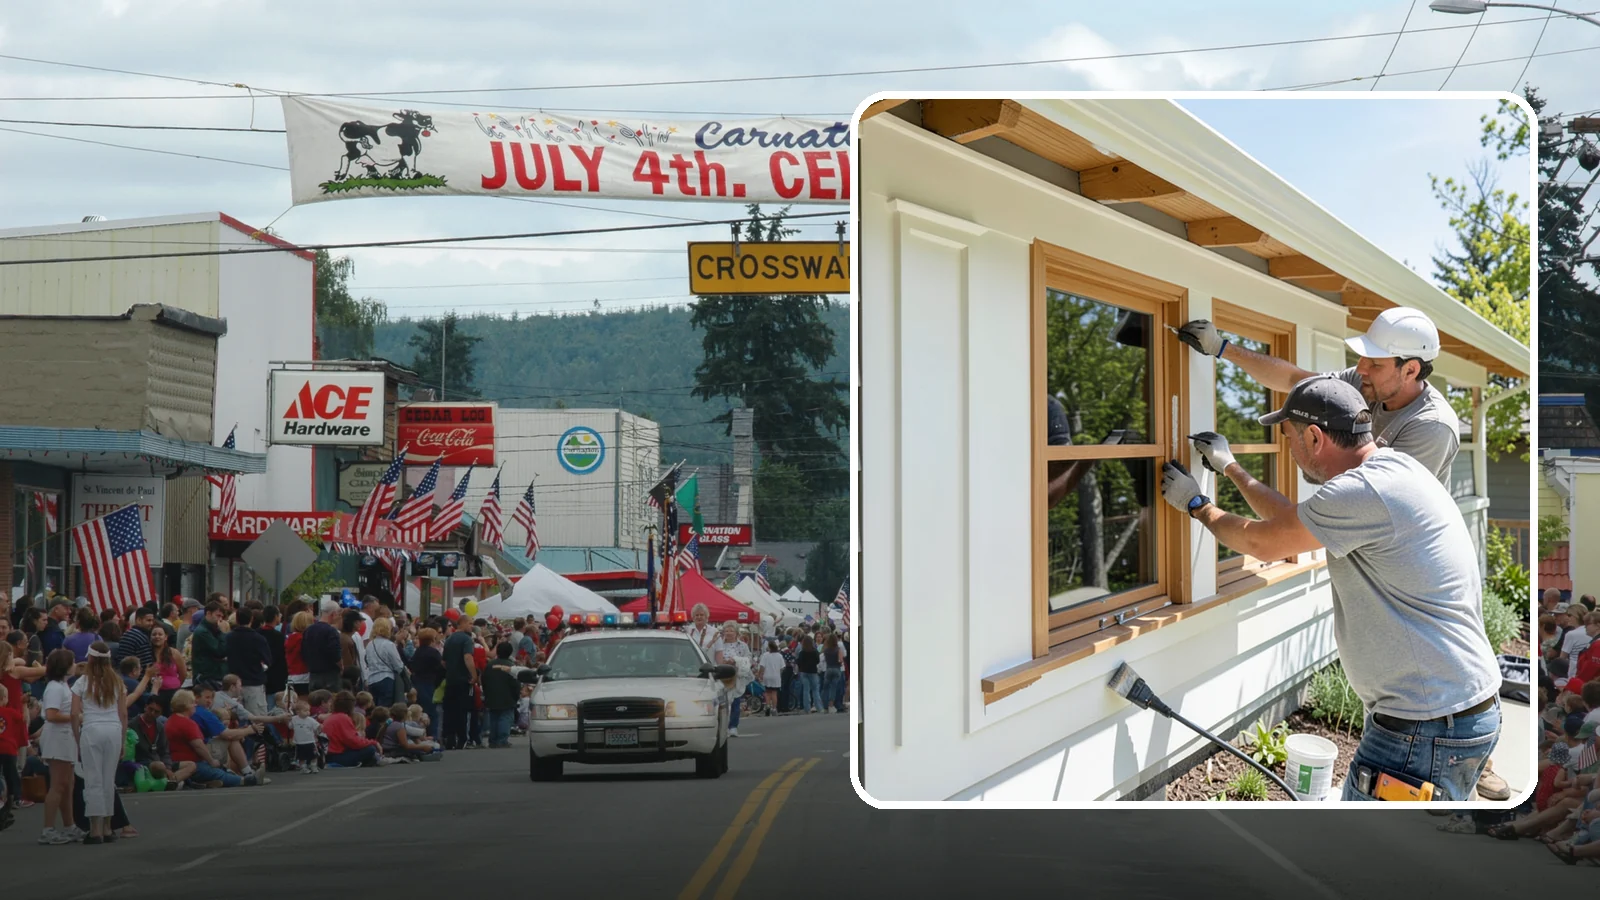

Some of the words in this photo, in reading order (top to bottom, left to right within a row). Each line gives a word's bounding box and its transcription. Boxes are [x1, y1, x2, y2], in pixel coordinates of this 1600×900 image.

[694, 121, 850, 150] Carnat
[481, 141, 604, 192] JULY
[632, 150, 746, 198] 4th.
[696, 253, 850, 280] CROSSWA
[282, 380, 373, 420] ACE
[406, 409, 452, 422] CEDAR
[283, 421, 370, 436] Hardware
[95, 485, 124, 495] Vincent
[126, 486, 136, 495] de
[137, 486, 155, 495] Paul
[81, 503, 153, 522] THT
[687, 526, 741, 536] CRNATION
[699, 535, 730, 544] GLASS
